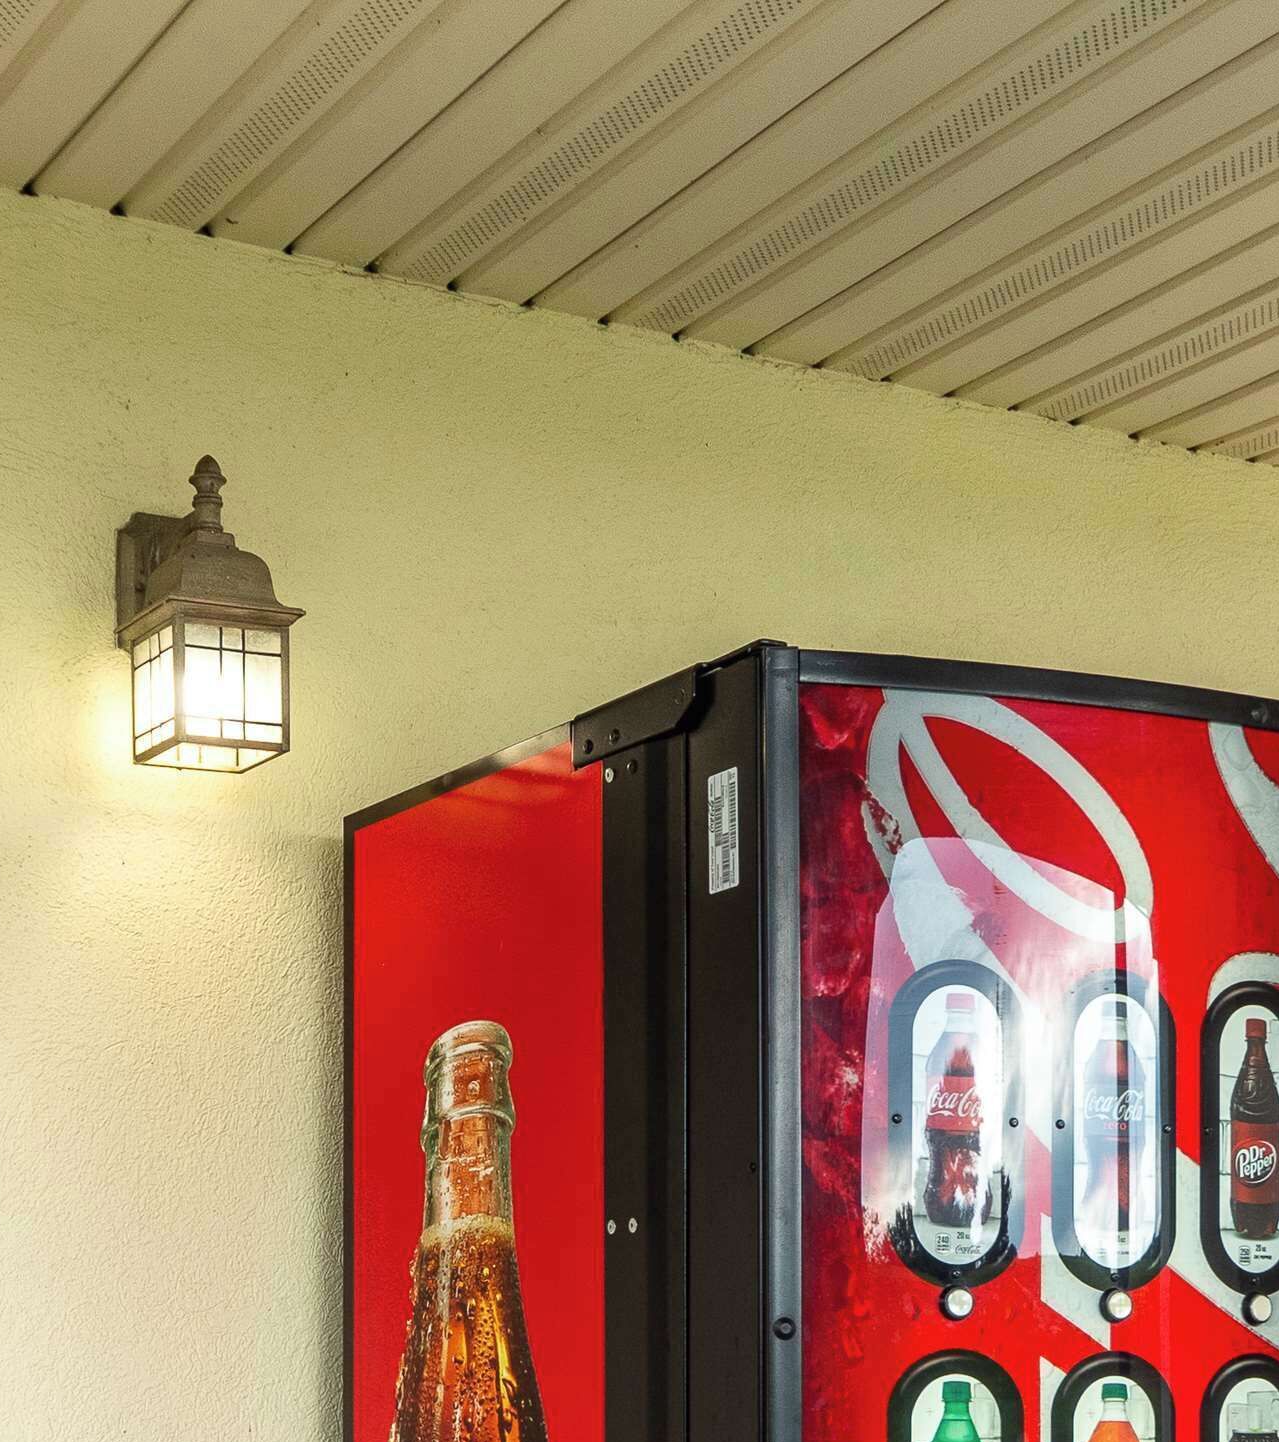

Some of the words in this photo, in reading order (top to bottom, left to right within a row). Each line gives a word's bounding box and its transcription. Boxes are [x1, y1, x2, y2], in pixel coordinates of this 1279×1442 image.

[1084, 1087, 1144, 1121] Coca-Cola
[1239, 1148, 1275, 1179] Pepper
[1249, 1145, 1265, 1160] Dr
